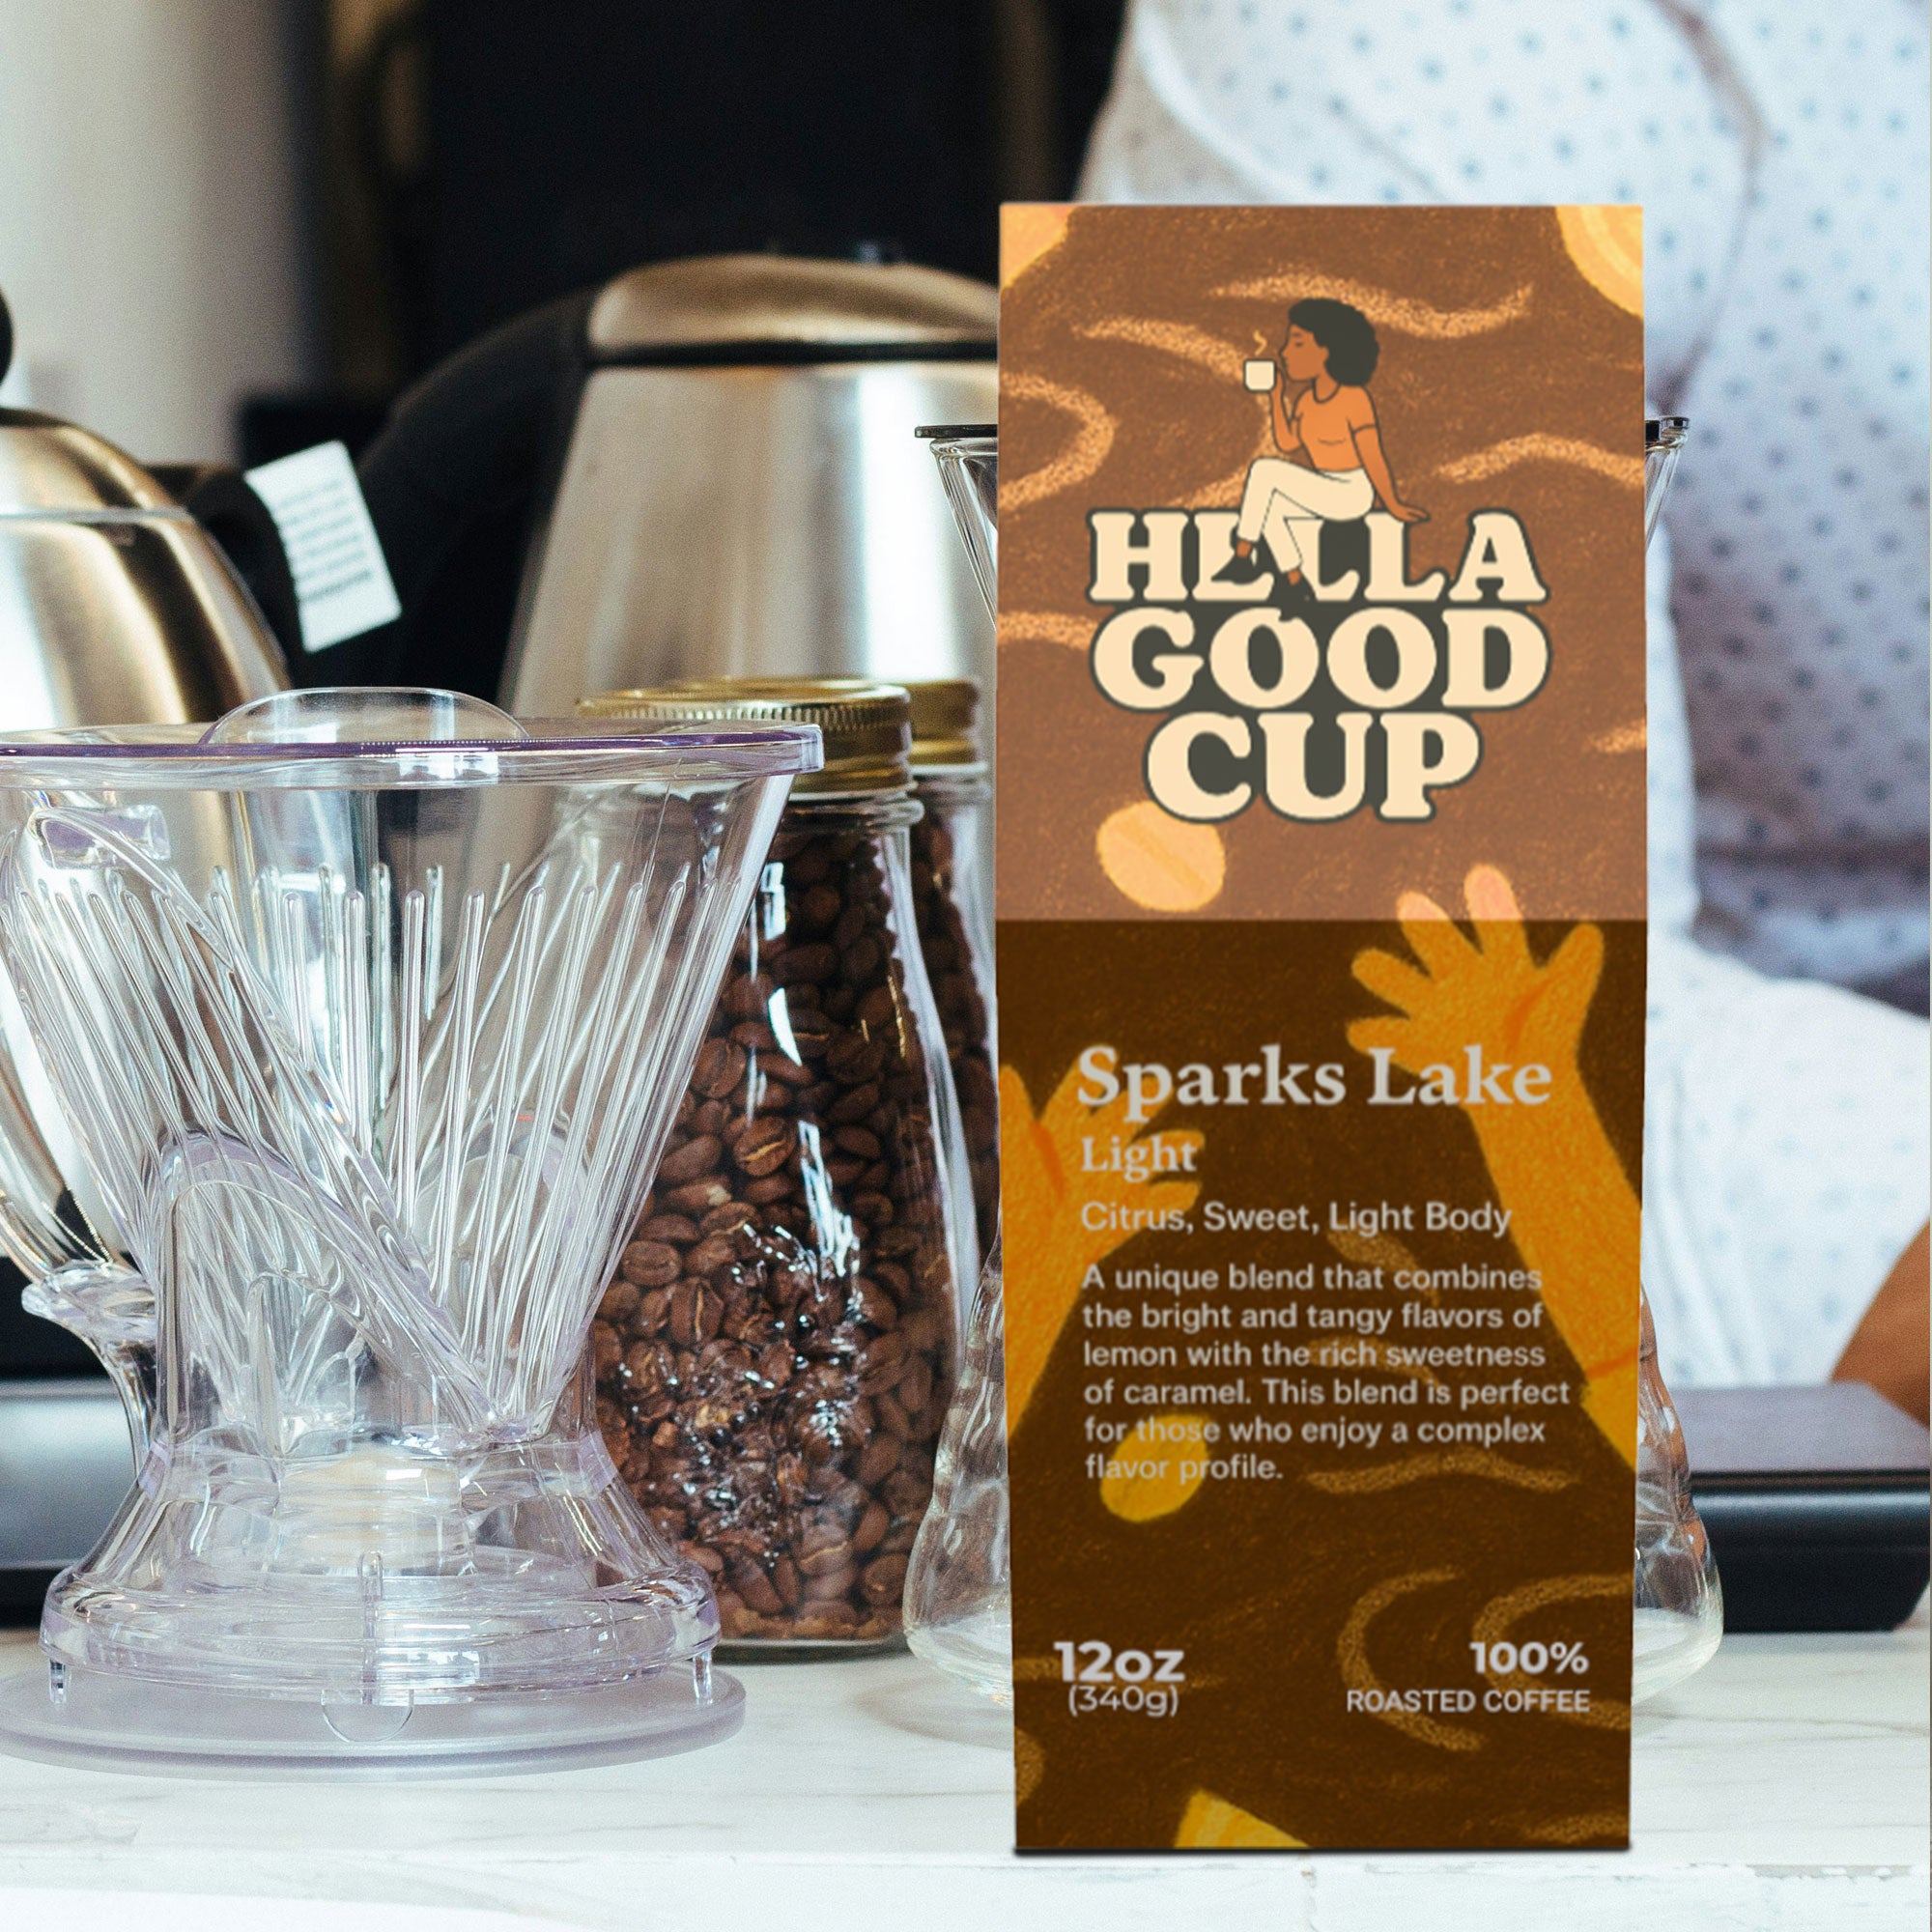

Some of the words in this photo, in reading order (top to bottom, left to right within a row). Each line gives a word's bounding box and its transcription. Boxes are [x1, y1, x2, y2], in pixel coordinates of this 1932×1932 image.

[1091, 605, 1550, 710] GOOD
[1145, 710, 1482, 822] CUP
[1077, 1043, 1347, 1123] Sparks
[1366, 1043, 1553, 1106] Lake
[1080, 1134, 1197, 1183] Light
[1080, 1200, 1194, 1236] Citrus,
[1203, 1200, 1320, 1236] Sweet,
[1329, 1200, 1414, 1238] Light
[1426, 1200, 1513, 1238] Body
[1081, 1265, 1105, 1291] A
[1115, 1264, 1219, 1295] unique
[1229, 1263, 1314, 1292] blend
[1323, 1263, 1384, 1292] that
[1393, 1263, 1544, 1292] combines
[1082, 1302, 1131, 1329] the
[1142, 1301, 1232, 1333] bright
[1241, 1301, 1297, 1329] and
[1307, 1303, 1392, 1334] tangy
[1402, 1301, 1503, 1329] flavors
[1513, 1301, 1544, 1329] of
[1084, 1341, 1177, 1368] lemon
[1186, 1340, 1252, 1368] with
[1262, 1341, 1310, 1368] the
[1320, 1340, 1378, 1368] rich
[1385, 1342, 1546, 1368] sweetness
[1083, 1378, 1114, 1406] of
[1123, 1378, 1253, 1406] caramel.
[1263, 1378, 1325, 1406] This
[1334, 1378, 1417, 1406] blend
[1428, 1378, 1451, 1406] is
[1460, 1378, 1571, 1410] perfect
[1084, 1415, 1126, 1443] for
[1137, 1415, 1220, 1443] those
[1229, 1415, 1293, 1443] who
[1301, 1416, 1382, 1448] enjoy
[1391, 1421, 1408, 1443] a
[1417, 1415, 1546, 1448] complex
[1086, 1454, 1168, 1480] flavor
[1179, 1454, 1283, 1485] profile.
[1053, 1640, 1186, 1683] 12oz
[1469, 1641, 1589, 1675] 100%
[1068, 1685, 1179, 1718] (340g)
[1346, 1689, 1477, 1714] ROASTED
[1483, 1689, 1591, 1714] COFFEE
